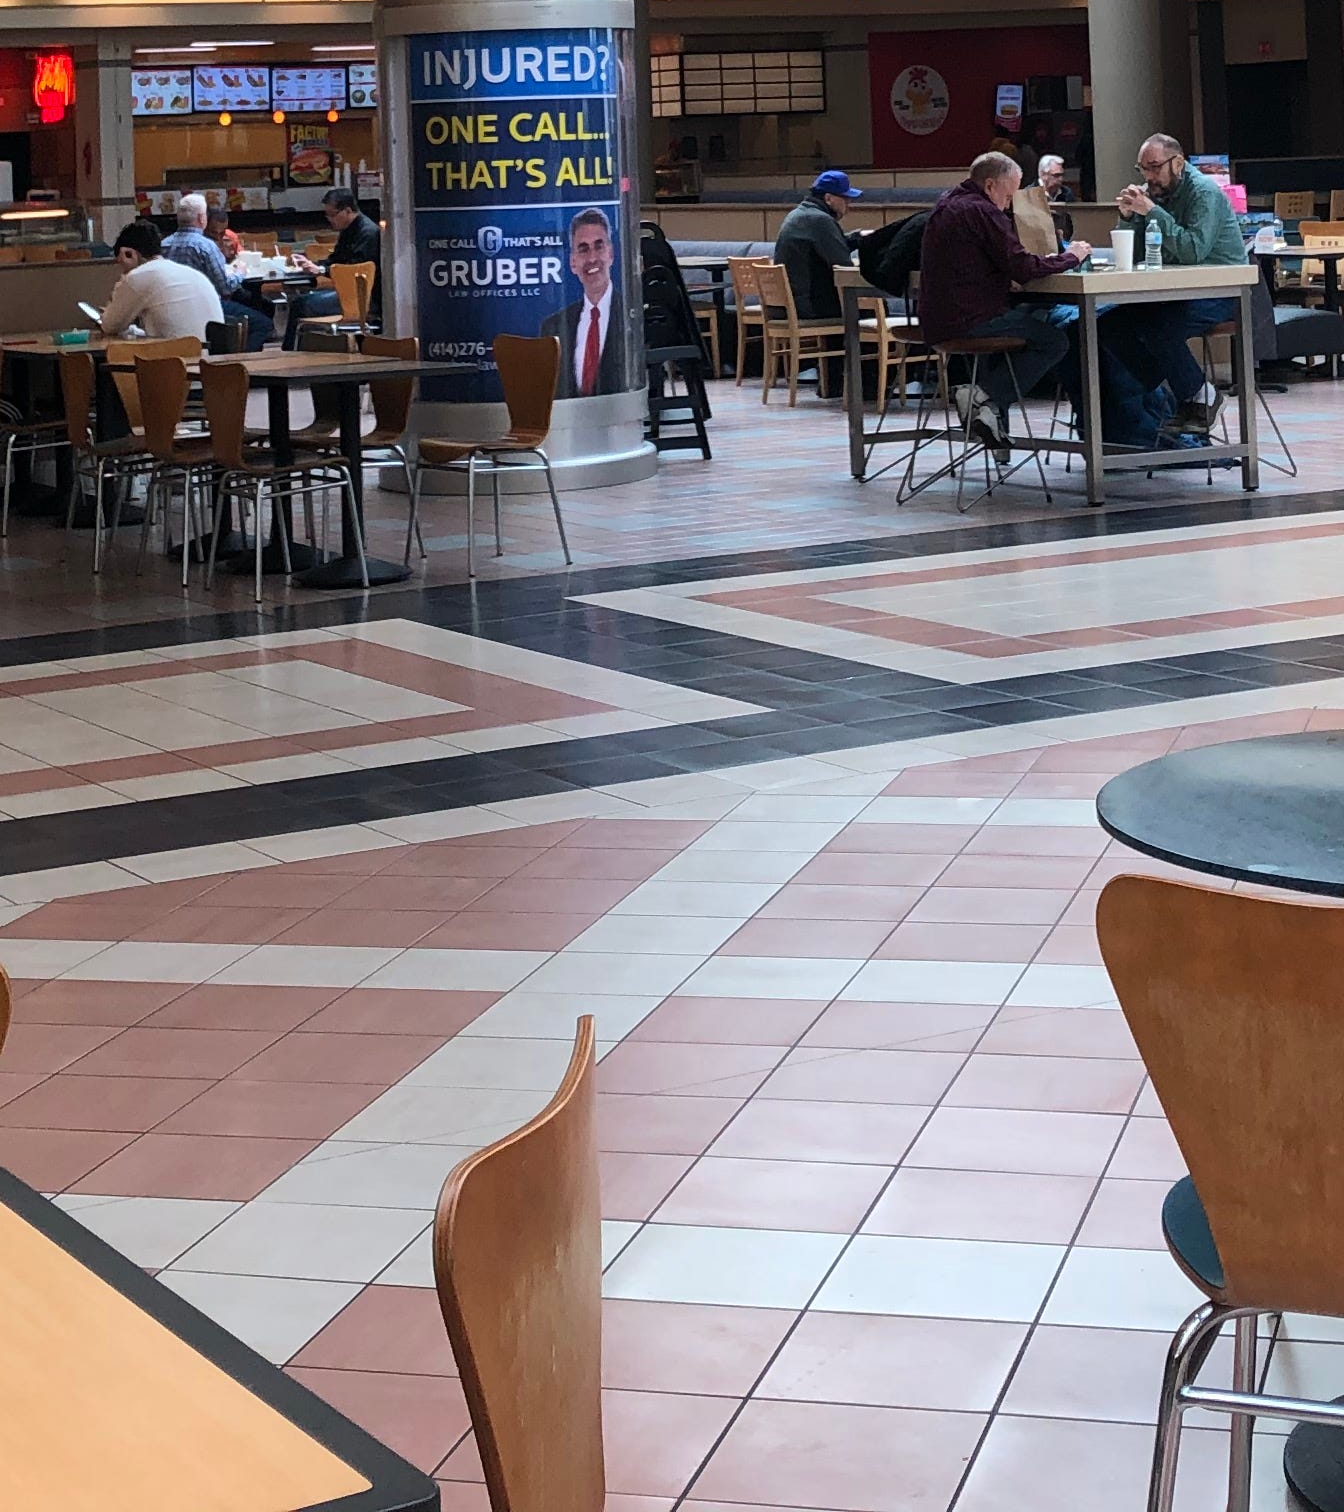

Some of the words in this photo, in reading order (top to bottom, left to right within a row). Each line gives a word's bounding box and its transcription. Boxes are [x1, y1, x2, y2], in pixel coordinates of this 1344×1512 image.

[423, 45, 609, 90] INJURED?
[425, 114, 499, 145] ONE
[508, 112, 610, 143] CALL...
[425, 158, 547, 190] THAT'S
[555, 157, 613, 186] ALL!
[429, 239, 449, 249] ONE
[450, 238, 476, 249] CALL
[503, 236, 542, 247] THAT'S
[543, 236, 563, 246] ALL
[429, 256, 563, 287] GRUBER
[473, 289, 518, 298] OFFICES
[521, 288, 540, 296] LLC
[428, 341, 494, 357] (414)276-
